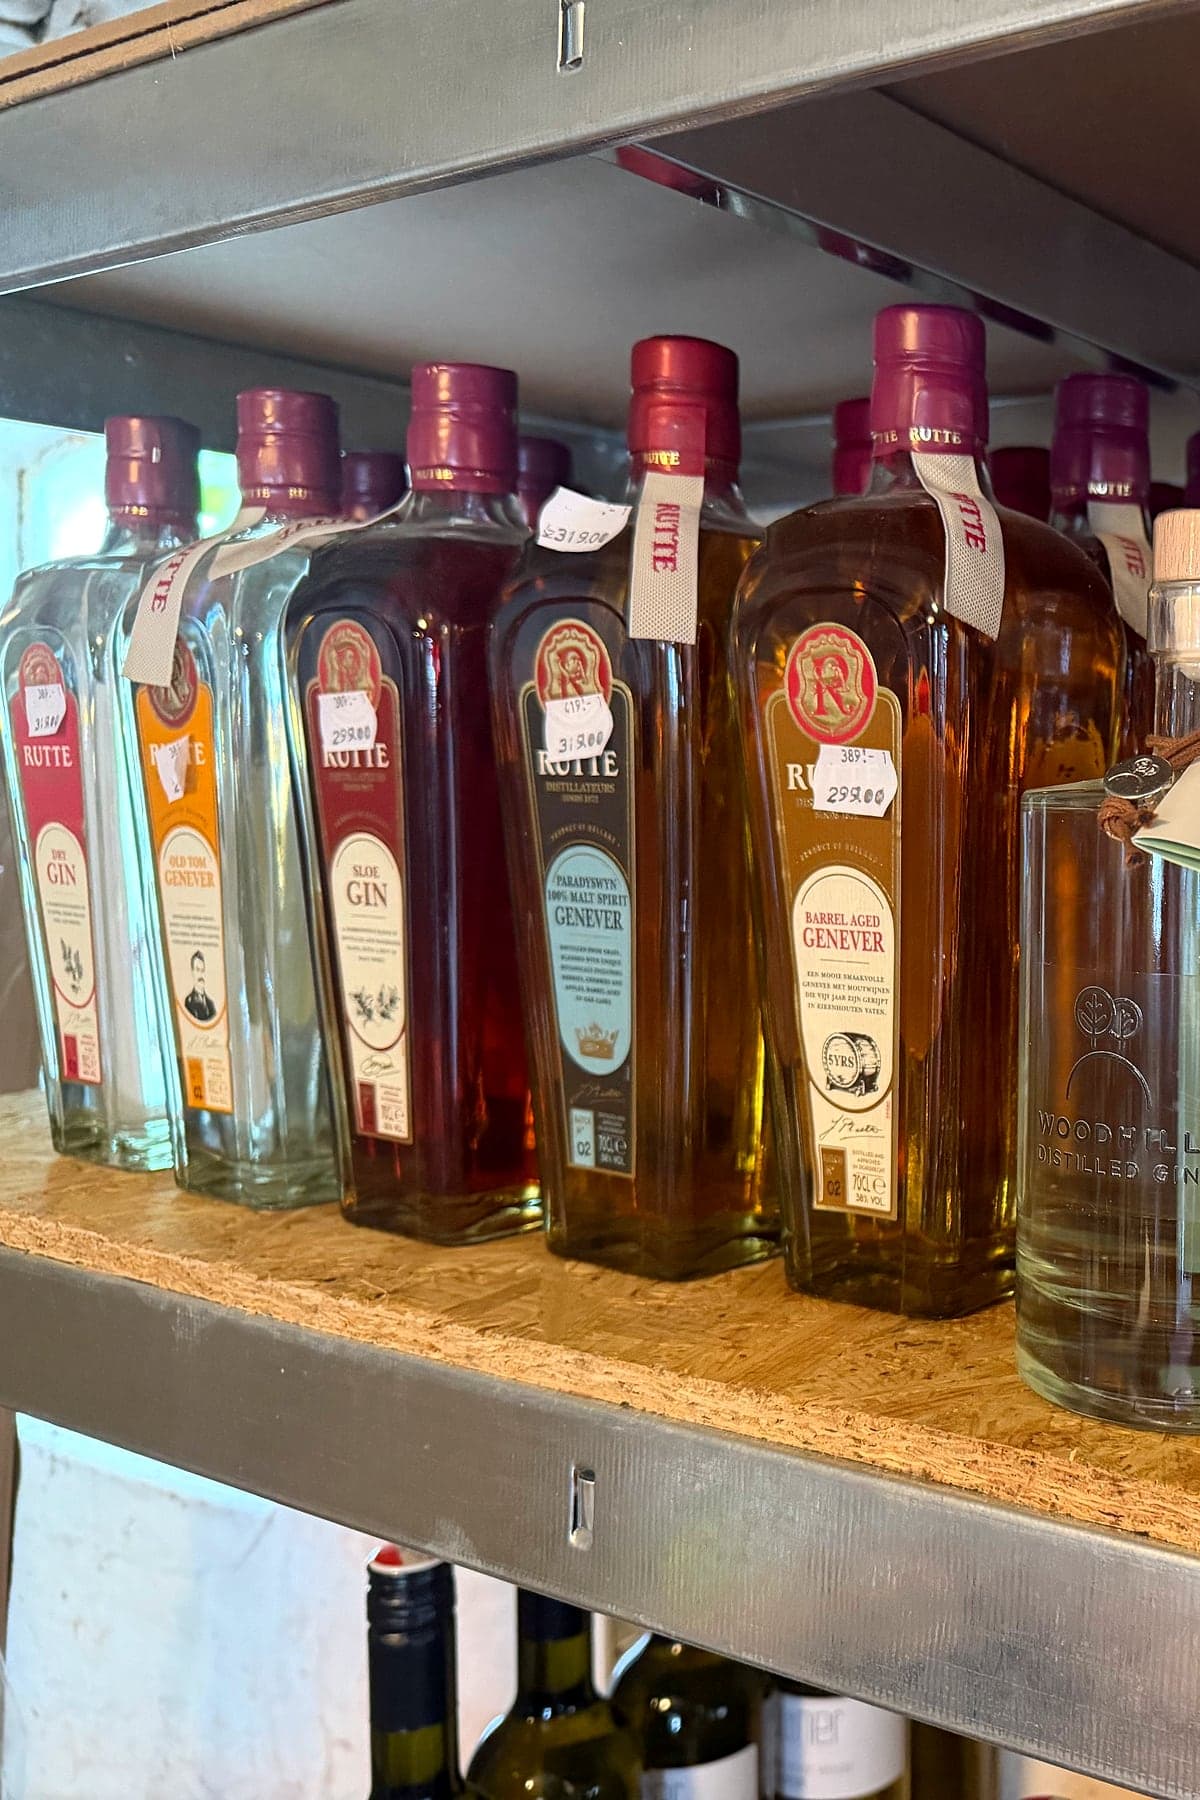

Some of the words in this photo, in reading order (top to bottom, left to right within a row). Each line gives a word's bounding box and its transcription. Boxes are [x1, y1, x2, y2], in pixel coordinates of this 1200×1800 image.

[909, 427, 962, 445] RUTTE
[652, 503, 681, 573] RUTTE
[23, 744, 73, 768] RUTTE
[827, 786, 885, 805] 299.00
[169, 855, 186, 868] OLD
[188, 856, 207, 869] TOM
[352, 865, 380, 878] SLOE
[47, 863, 77, 885] GIN
[165, 869, 216, 888] GENEVER
[556, 875, 617, 890] PARADYSWYN
[346, 880, 388, 907] GIN
[570, 891, 594, 905] MALT
[597, 893, 629, 907] SPIRIT
[555, 905, 624, 931] GENEVER
[805, 911, 848, 926] BARREL
[850, 914, 881, 928] AGED
[803, 927, 886, 953] GENEVER
[828, 1054, 854, 1069] 5YRS
[1038, 1110, 1200, 1154] WOODHILL
[577, 1141, 592, 1156] 02
[1038, 1143, 1140, 1180] DISTILLED
[1153, 1163, 1200, 1186] GIN
[827, 1180, 842, 1196] 02
